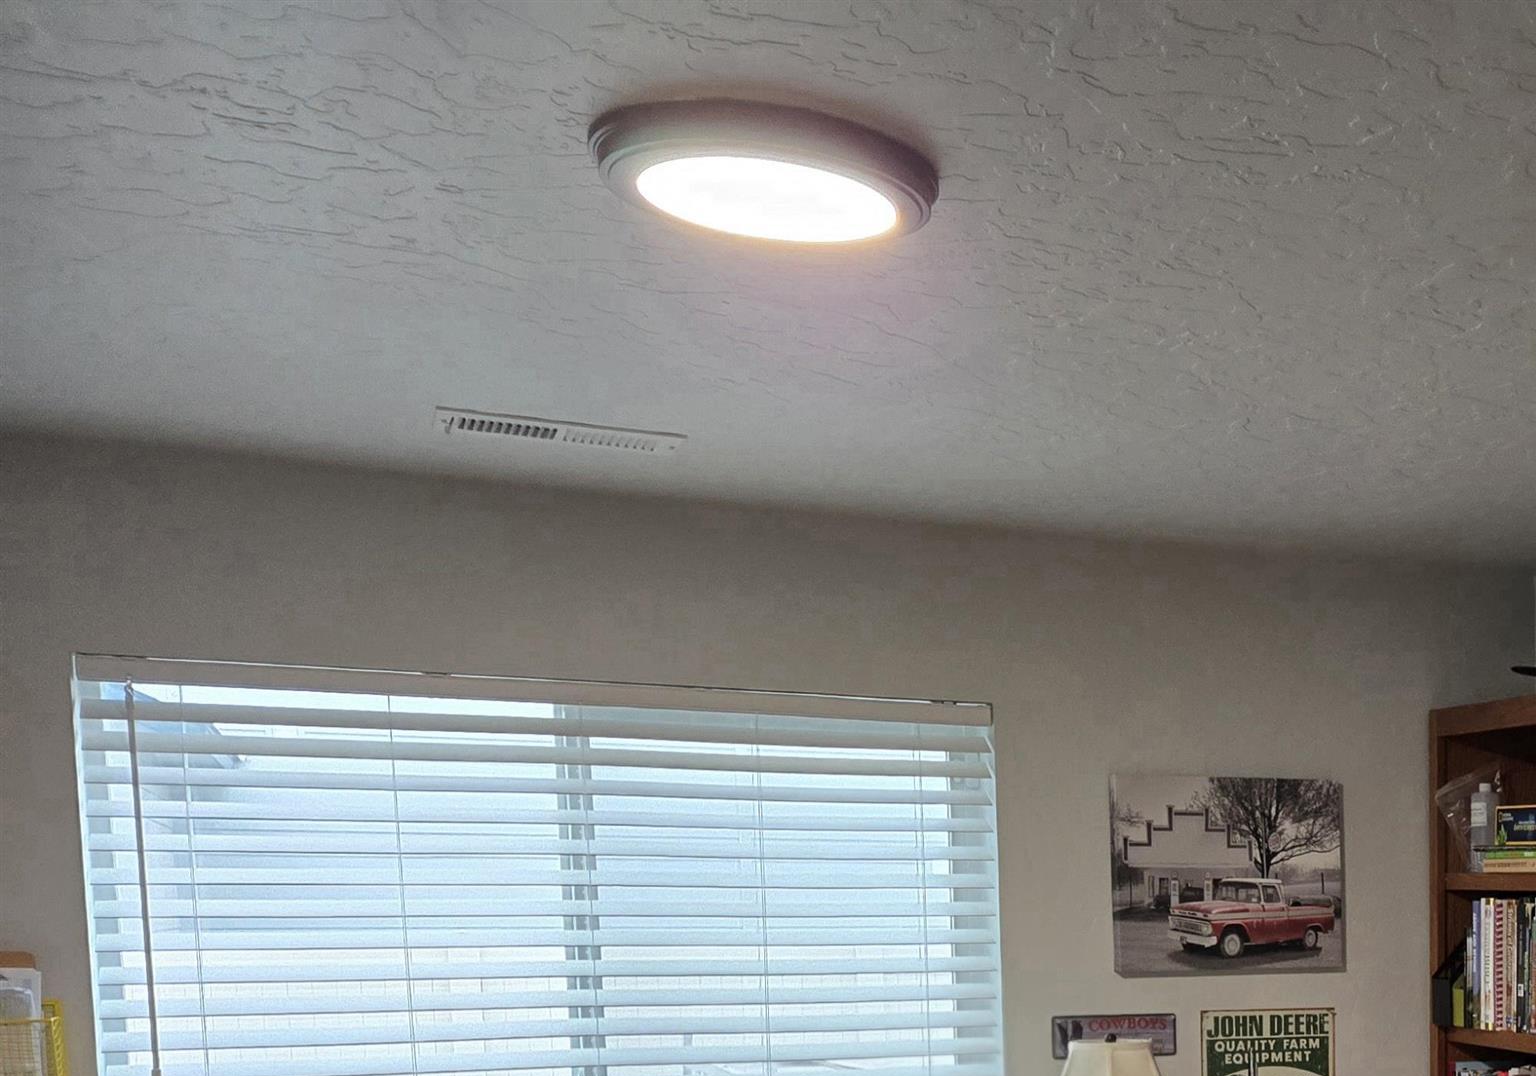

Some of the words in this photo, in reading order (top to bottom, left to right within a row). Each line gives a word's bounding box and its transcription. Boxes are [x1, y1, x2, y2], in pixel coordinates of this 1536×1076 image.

[1088, 1017, 1168, 1032] COWBOYS
[1206, 1014, 1264, 1038] JOHN
[1269, 1013, 1329, 1036] DEERE
[1214, 1039, 1276, 1052] QUALITY
[1283, 1038, 1320, 1050] FARM
[1224, 1051, 1311, 1065] EQUIPMENT
